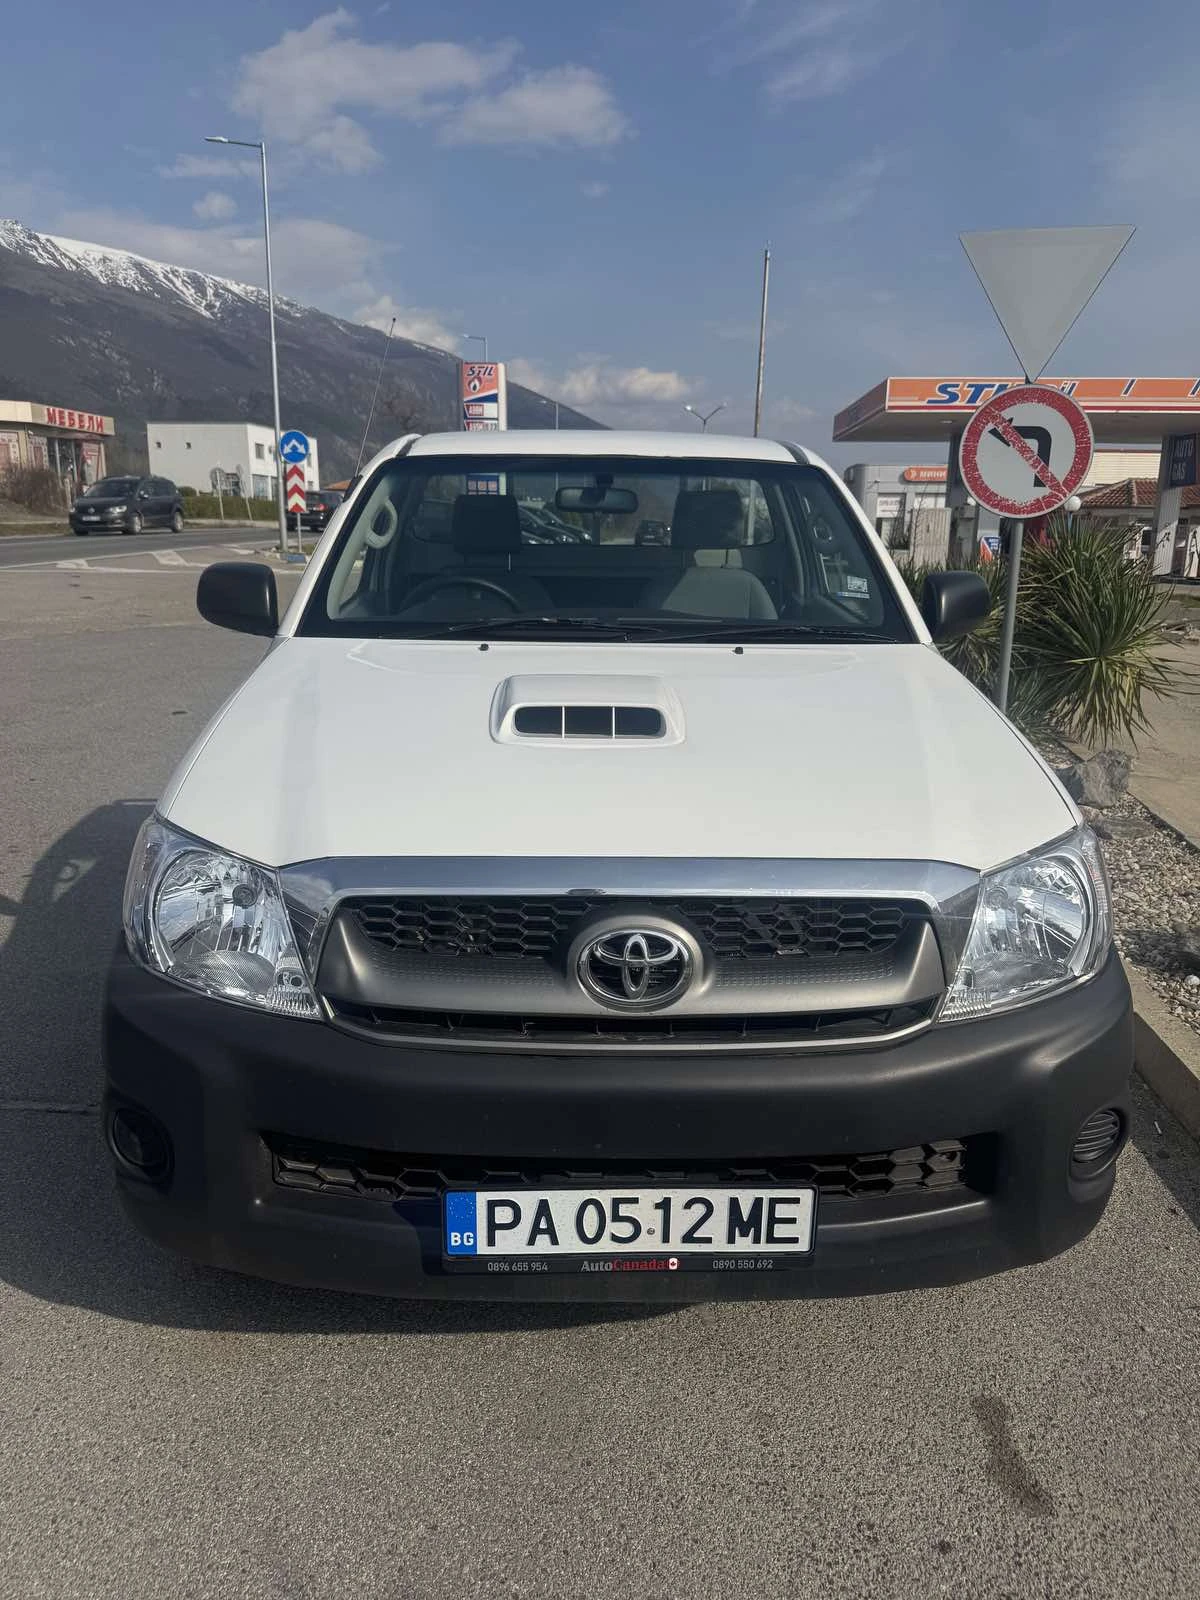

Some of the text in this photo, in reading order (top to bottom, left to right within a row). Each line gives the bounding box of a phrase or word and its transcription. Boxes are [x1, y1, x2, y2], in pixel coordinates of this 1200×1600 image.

[47, 407, 105, 433] МЕБЕЛИ
[487, 1196, 801, 1247] PA 0512 ME
[450, 1231, 474, 1247] BG
[487, 1261, 548, 1272] 0896 655 954
[712, 1259, 774, 1270] 0890 550 692
